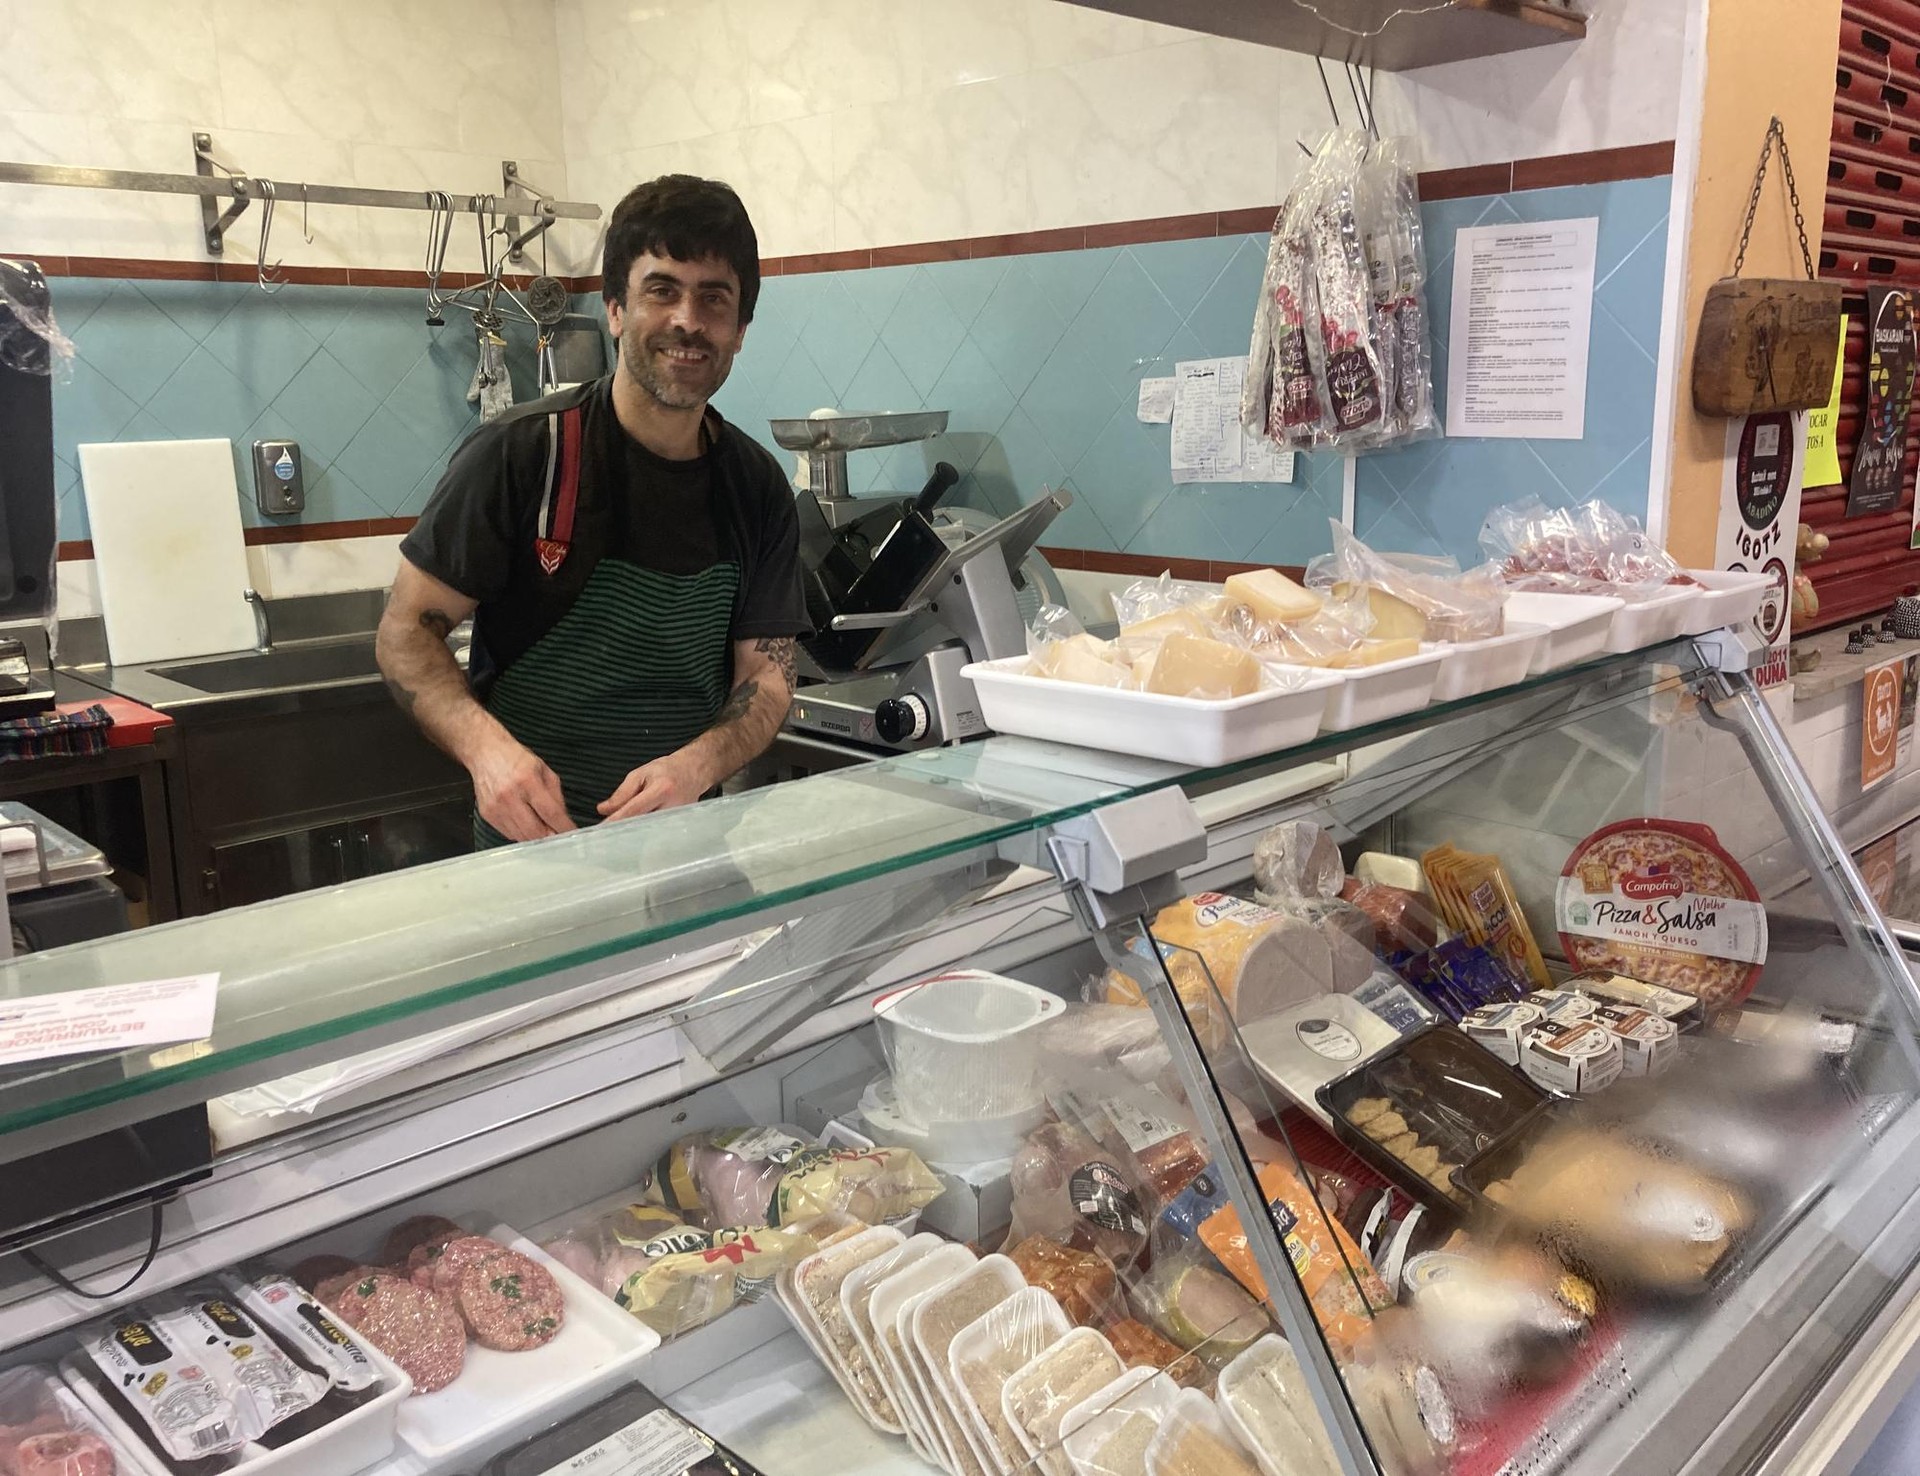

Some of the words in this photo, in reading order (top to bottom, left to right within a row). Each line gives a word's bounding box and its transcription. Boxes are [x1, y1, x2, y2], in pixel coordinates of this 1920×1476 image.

[1808, 414, 1828, 428] OCAR
[1735, 519, 1782, 561] IGOTZ
[1756, 662, 1788, 686] DUNA
[1593, 901, 1641, 928] Pizza
[1642, 905, 1658, 925] &
[1657, 901, 1716, 934] Salsa
[1652, 931, 1660, 941] Y
[1661, 933, 1699, 947] QUESO
